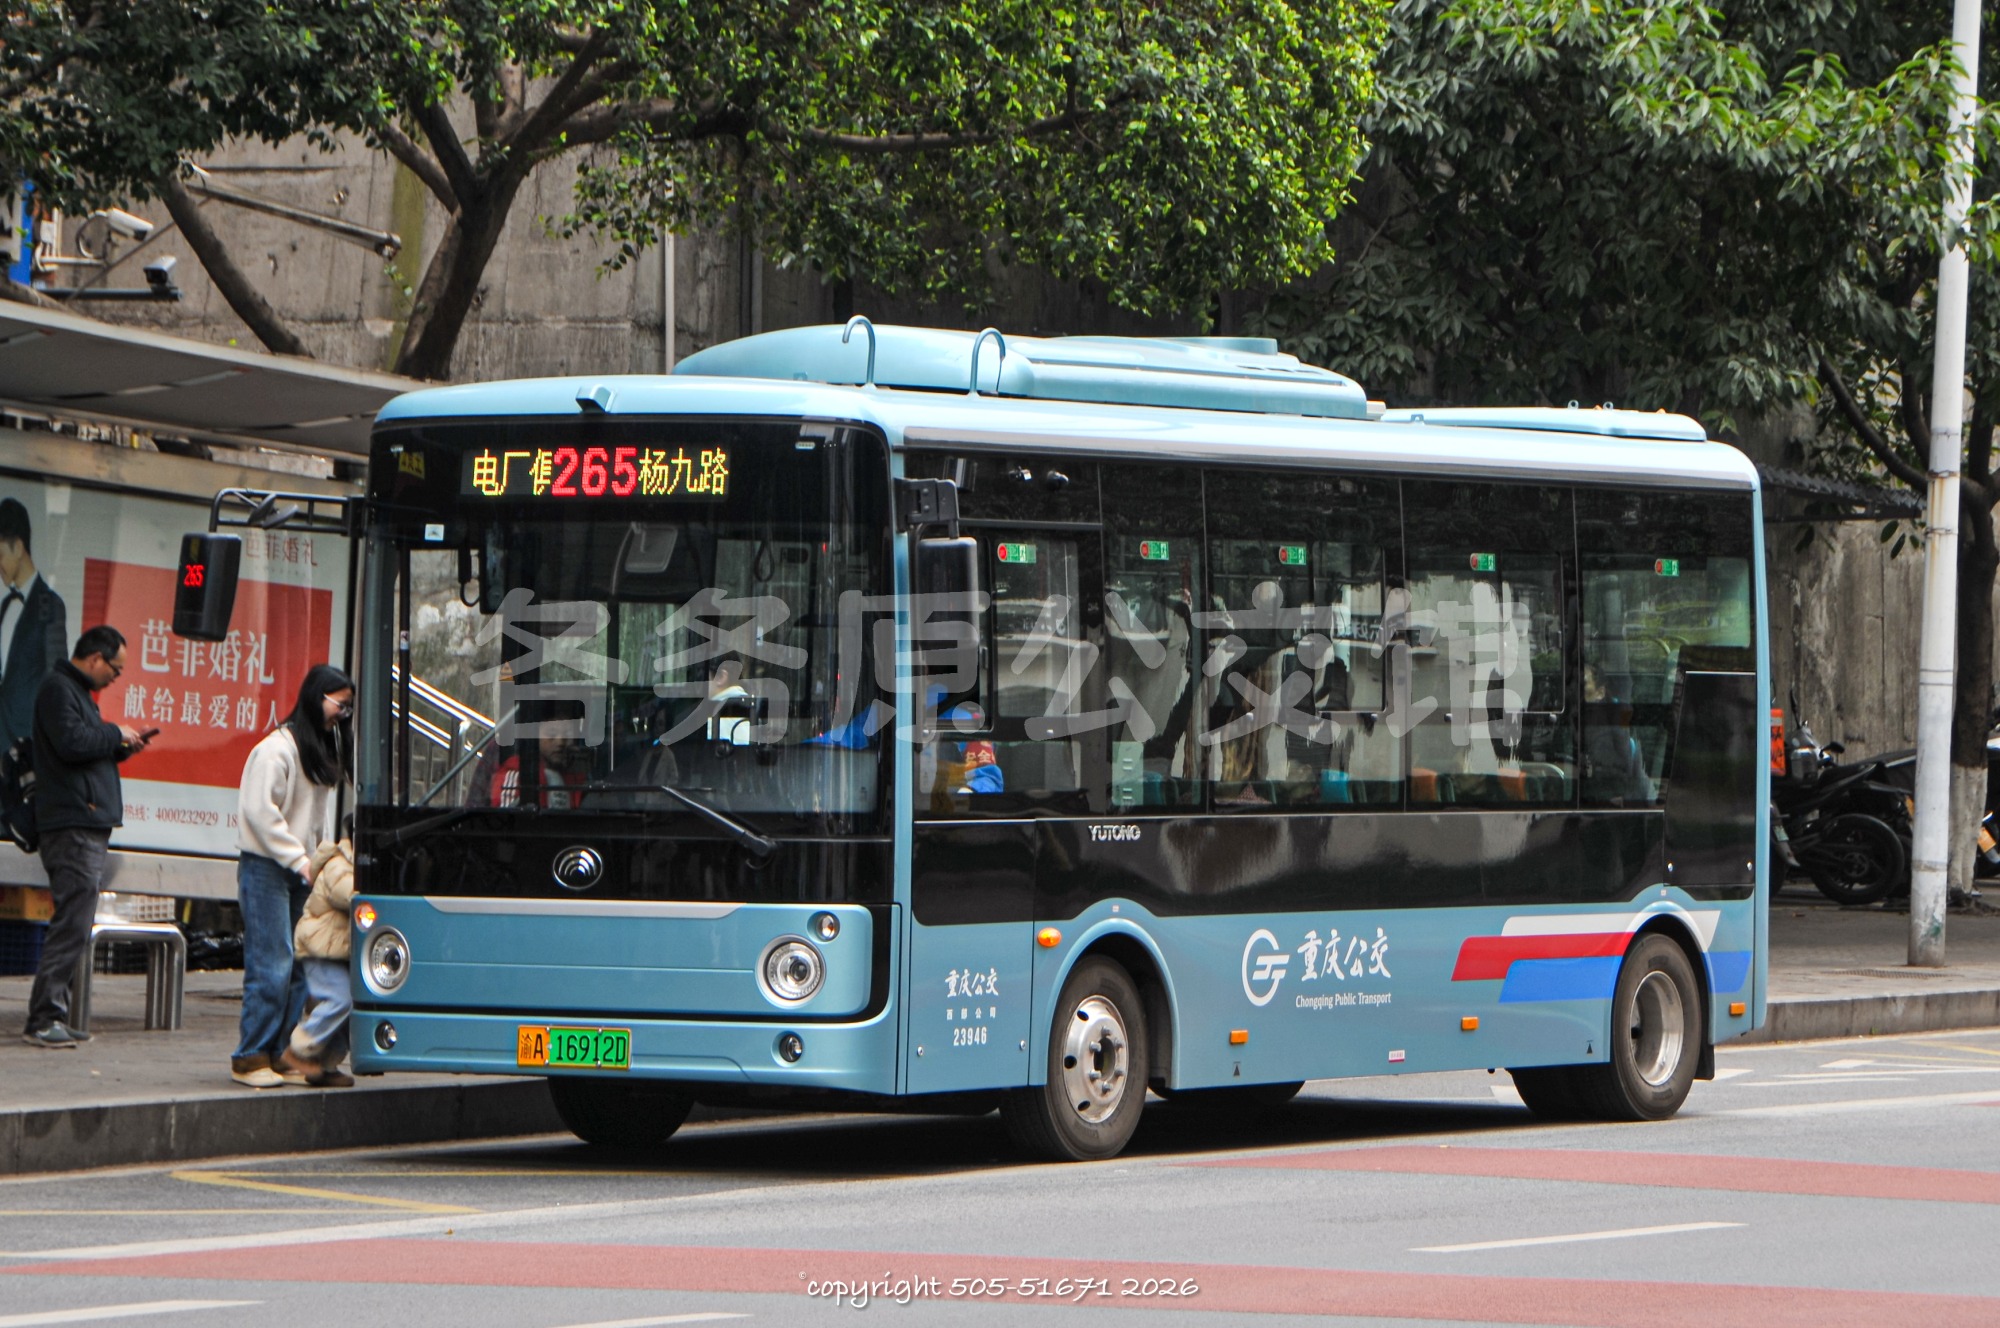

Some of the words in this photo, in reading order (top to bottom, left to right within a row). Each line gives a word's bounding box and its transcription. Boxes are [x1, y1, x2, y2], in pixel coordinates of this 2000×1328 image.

[551, 447, 638, 496] 265
[638, 447, 730, 496] 杨九路
[184, 564, 205, 588] 265
[140, 618, 275, 685] 芭菲婚礼
[124, 684, 280, 733] 献给最爱的人
[155, 807, 219, 826] 4000232929
[1088, 824, 1141, 842] YUTONG
[1297, 927, 1392, 982] 重庆公交
[945, 967, 999, 998] 重庆公交
[1295, 995, 1333, 1010] Chongqing
[1335, 993, 1356, 1006] Public
[1358, 992, 1392, 1008] Transport
[953, 1026, 987, 1047] 23946
